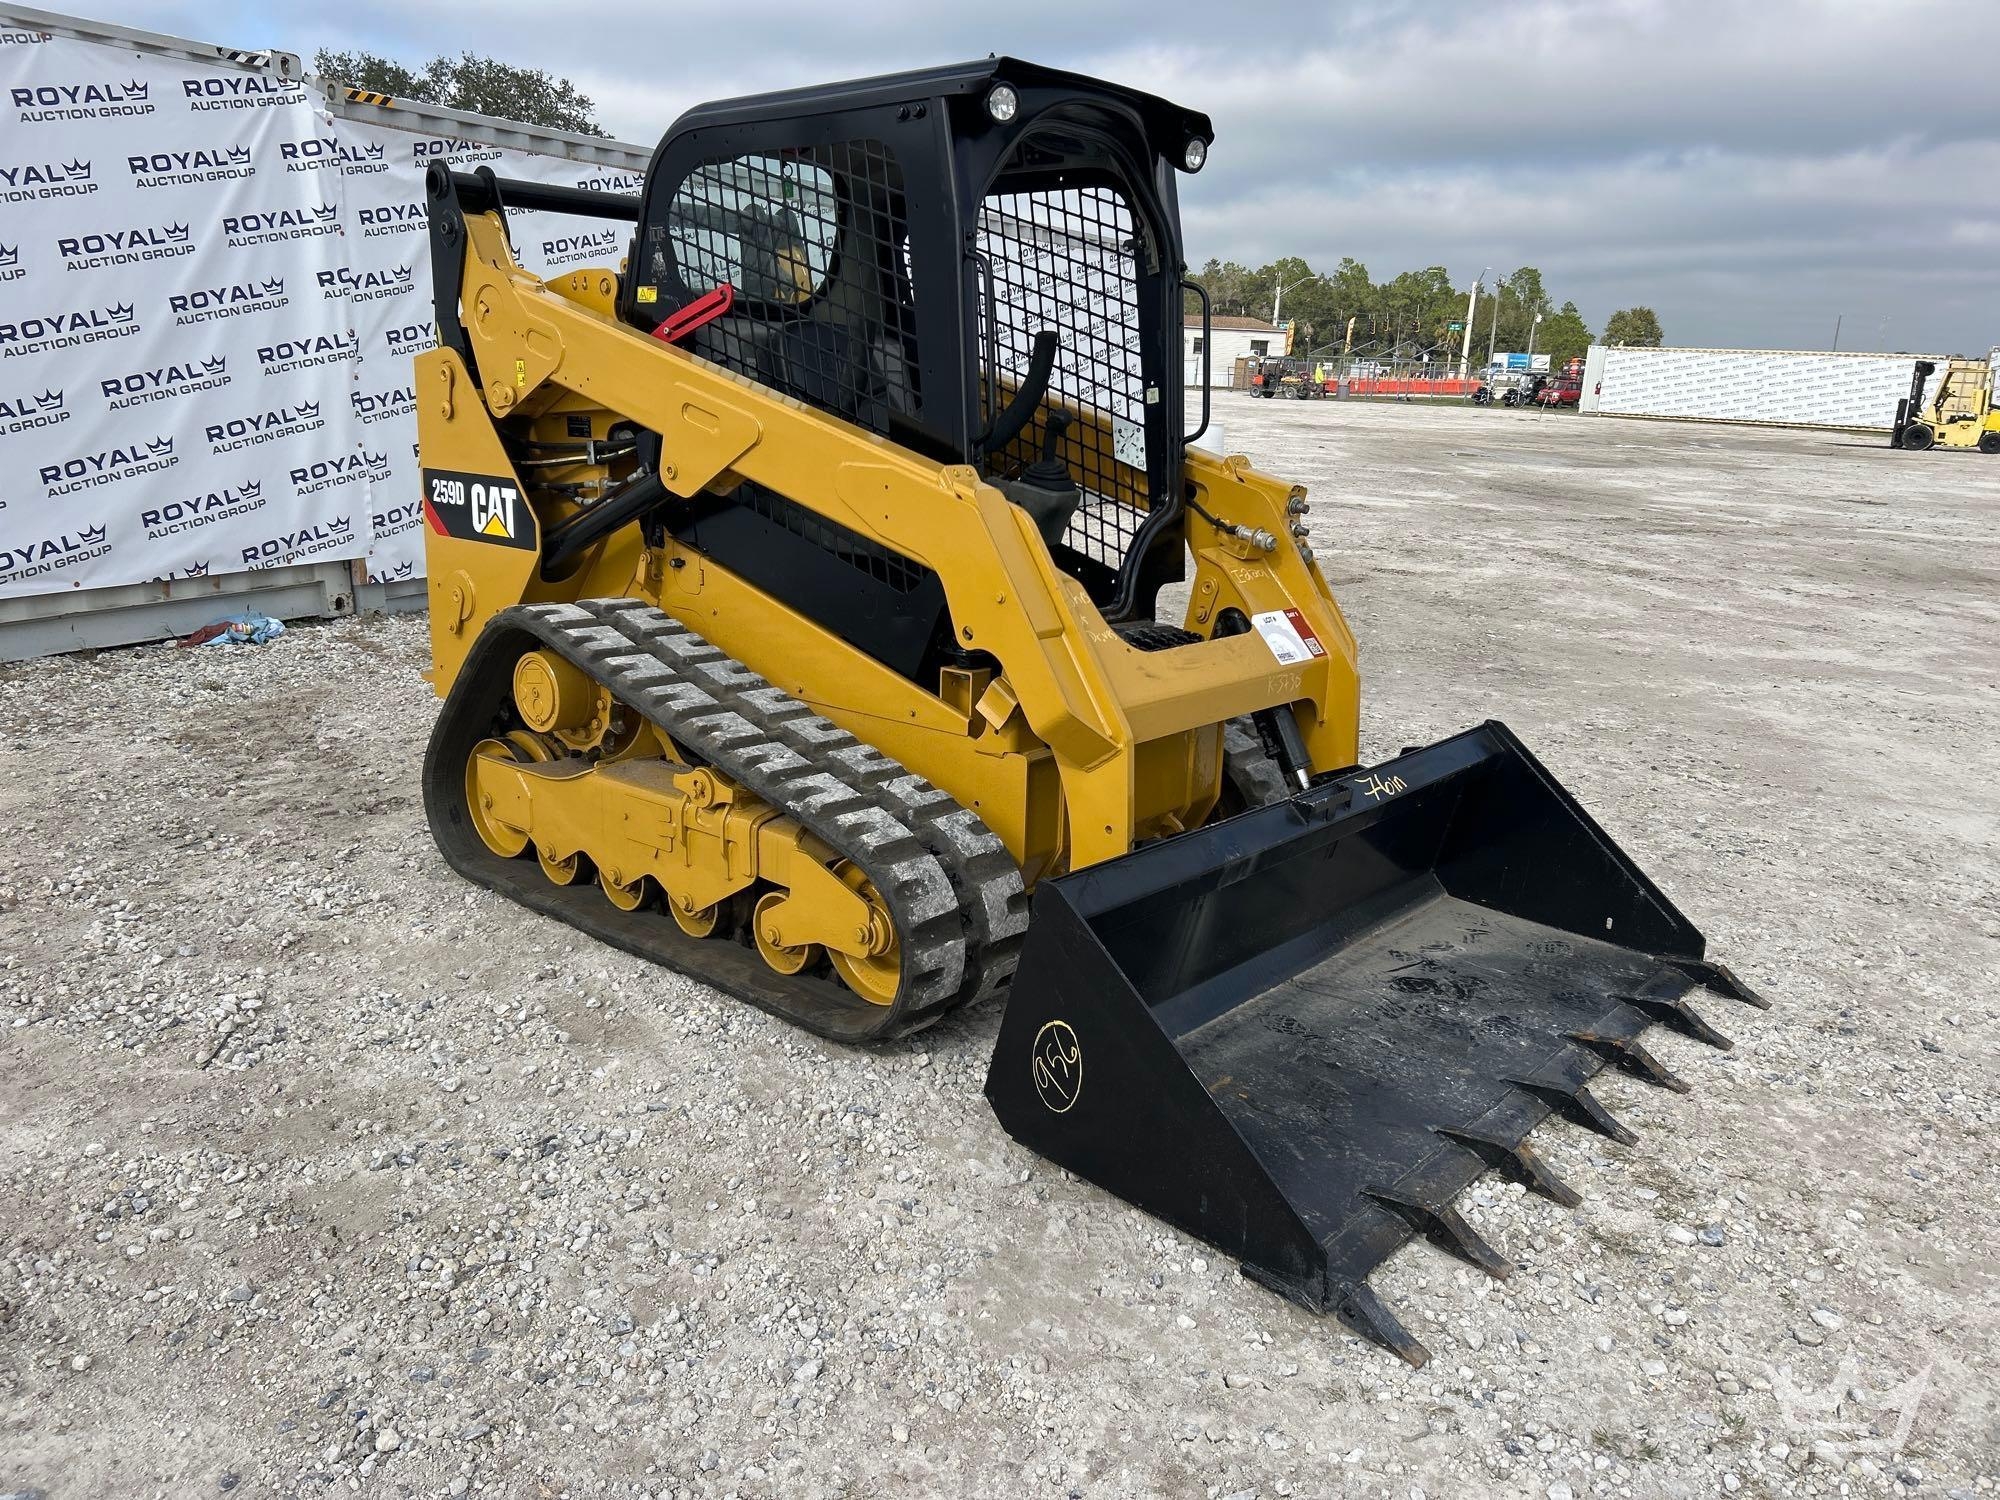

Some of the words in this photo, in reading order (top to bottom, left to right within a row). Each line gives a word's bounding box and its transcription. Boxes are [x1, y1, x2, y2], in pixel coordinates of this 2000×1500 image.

[0, 32, 52, 44] ROUP
[11, 84, 124, 107] ROYAL
[183, 76, 278, 97] ROYAL
[20, 108, 96, 122] AUCTION
[100, 104, 155, 117] GROUP
[191, 98, 256, 111] AUCTION
[258, 94, 307, 106] GROUP
[280, 138, 367, 160] ROYAL
[466, 152, 502, 162] GROUP
[128, 149, 228, 175] ROYAL
[287, 158, 344, 176] AUCTIO
[346, 164, 388, 175] GROUP
[0, 164, 65, 187] YAL
[136, 174, 204, 188] AUCTION
[206, 168, 256, 181] GROUP
[39, 184, 98, 199] GROUP
[223, 208, 314, 234] ROYAL
[364, 222, 416, 238] AUCTION
[58, 228, 165, 257] ROYAL
[228, 232, 288, 248] AUCTION
[290, 224, 341, 239] GROUP
[543, 234, 602, 256] ROYAL
[67, 253, 139, 271] AUCTION
[143, 245, 195, 260] GROUP
[546, 252, 587, 266] AUCTION
[588, 246, 618, 257] GROUP
[169, 283, 263, 313] ROYAL
[324, 287, 373, 303] AUCION
[376, 284, 414, 298] GROUP
[176, 307, 240, 326] AUCTION
[242, 298, 289, 314] GROUP
[0, 310, 108, 343] ROYAL
[386, 322, 432, 345] ROY
[4, 336, 80, 358] AUCTION
[84, 325, 140, 342] GROUP
[258, 334, 348, 364] ROYAL
[264, 353, 326, 376] AUCTION
[101, 364, 203, 397] ROYAL
[109, 389, 177, 411] AUCTION
[180, 376, 231, 395] GROUP
[10, 412, 70, 434] GROUP
[206, 408, 296, 442] ROYAL
[355, 408, 400, 424] ACTION
[212, 433, 274, 455] AUCTION
[277, 420, 325, 438] GROUP
[39, 446, 148, 485] ROYAL
[48, 472, 121, 498] AUCTION
[124, 457, 178, 477] GROUP
[297, 473, 356, 496] AUCTION
[141, 490, 240, 528] ROYAL
[148, 514, 215, 540] AUCTION
[219, 499, 266, 519] GROUP
[372, 500, 424, 530] ROYA
[432, 479, 464, 506] 259D
[470, 484, 517, 538] CAT
[0, 536, 80, 572] OYAL
[54, 544, 112, 568] GROUP
[242, 526, 329, 563] ROYAL
[308, 534, 355, 554] GROUP
